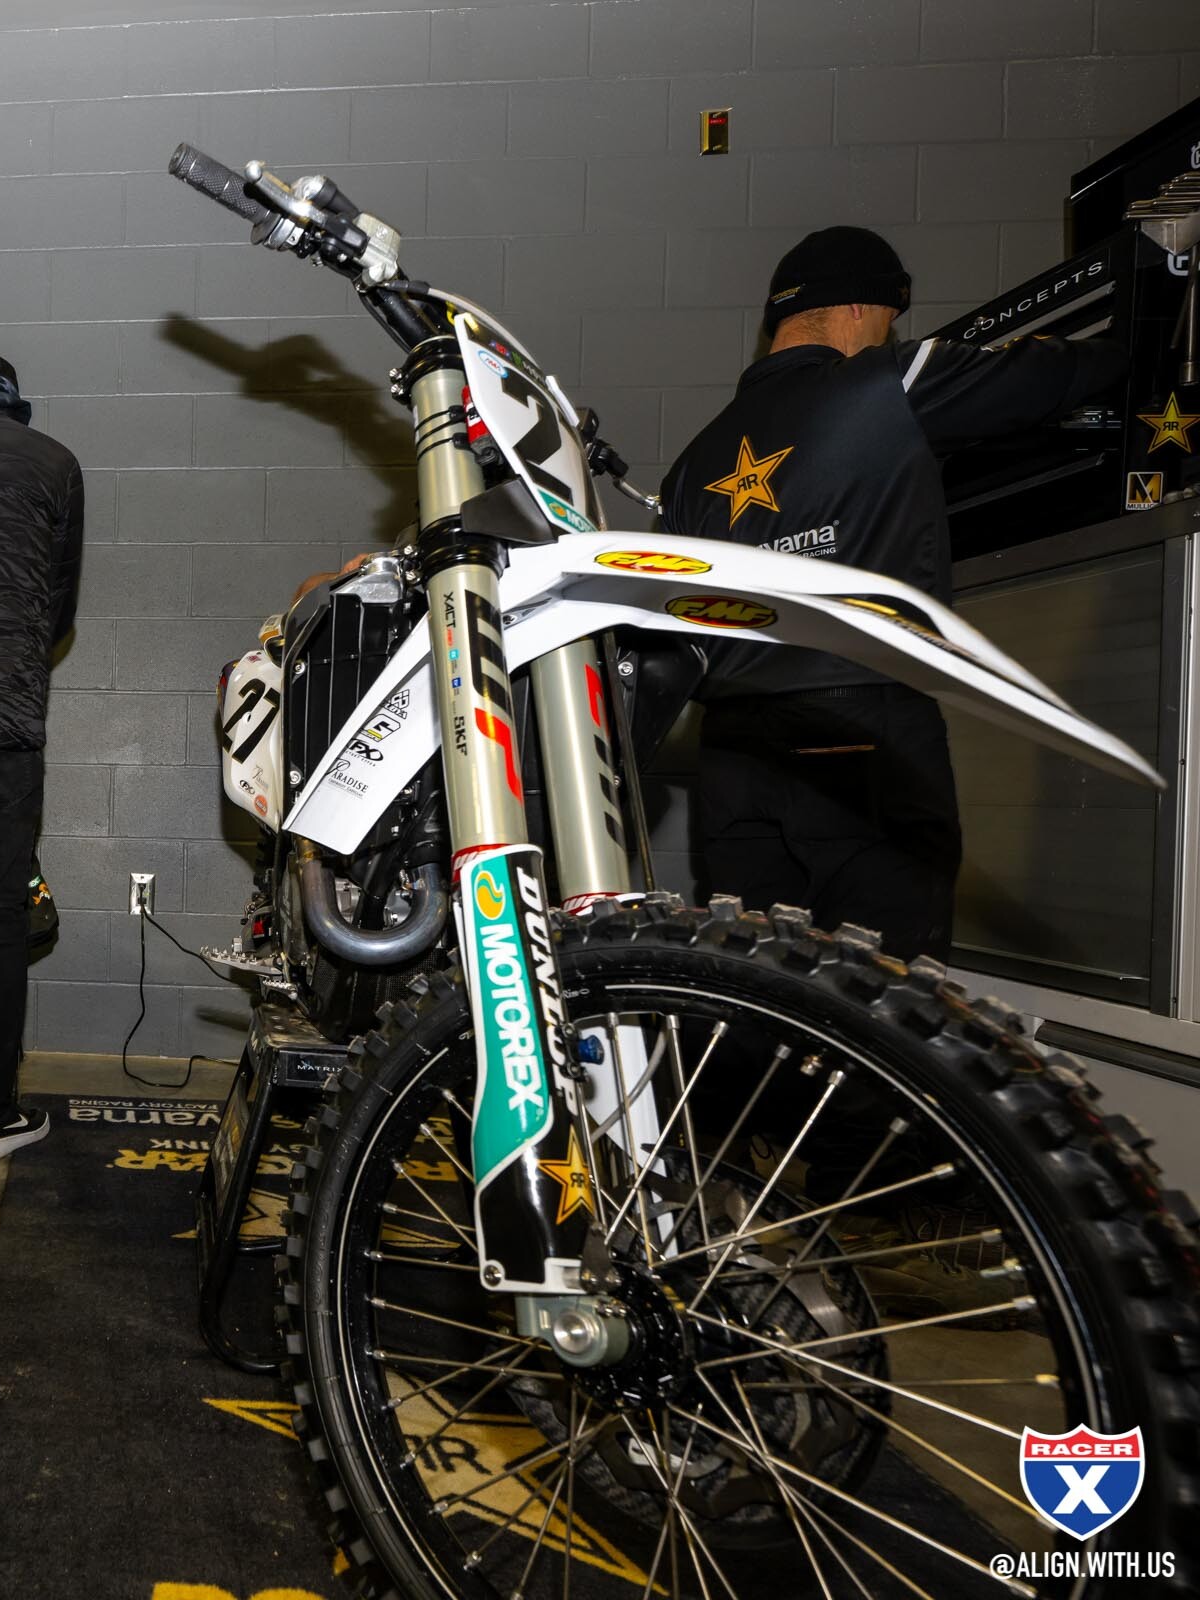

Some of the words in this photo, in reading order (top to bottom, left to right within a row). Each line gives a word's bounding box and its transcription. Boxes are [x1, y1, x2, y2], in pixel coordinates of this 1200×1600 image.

[963, 261, 1103, 340] CONCEPTS
[771, 524, 836, 552] varna
[595, 551, 712, 574] FMF
[443, 591, 457, 629] XACT
[666, 597, 777, 628] FMF
[223, 678, 281, 765] 27
[454, 715, 468, 757] SKF
[480, 925, 545, 1111] MOTOREX
[297, 1064, 343, 1073] MATRIX
[69, 1099, 133, 1107] RACING
[69, 1107, 222, 1128] varna
[138, 1102, 219, 1112] FACTORY
